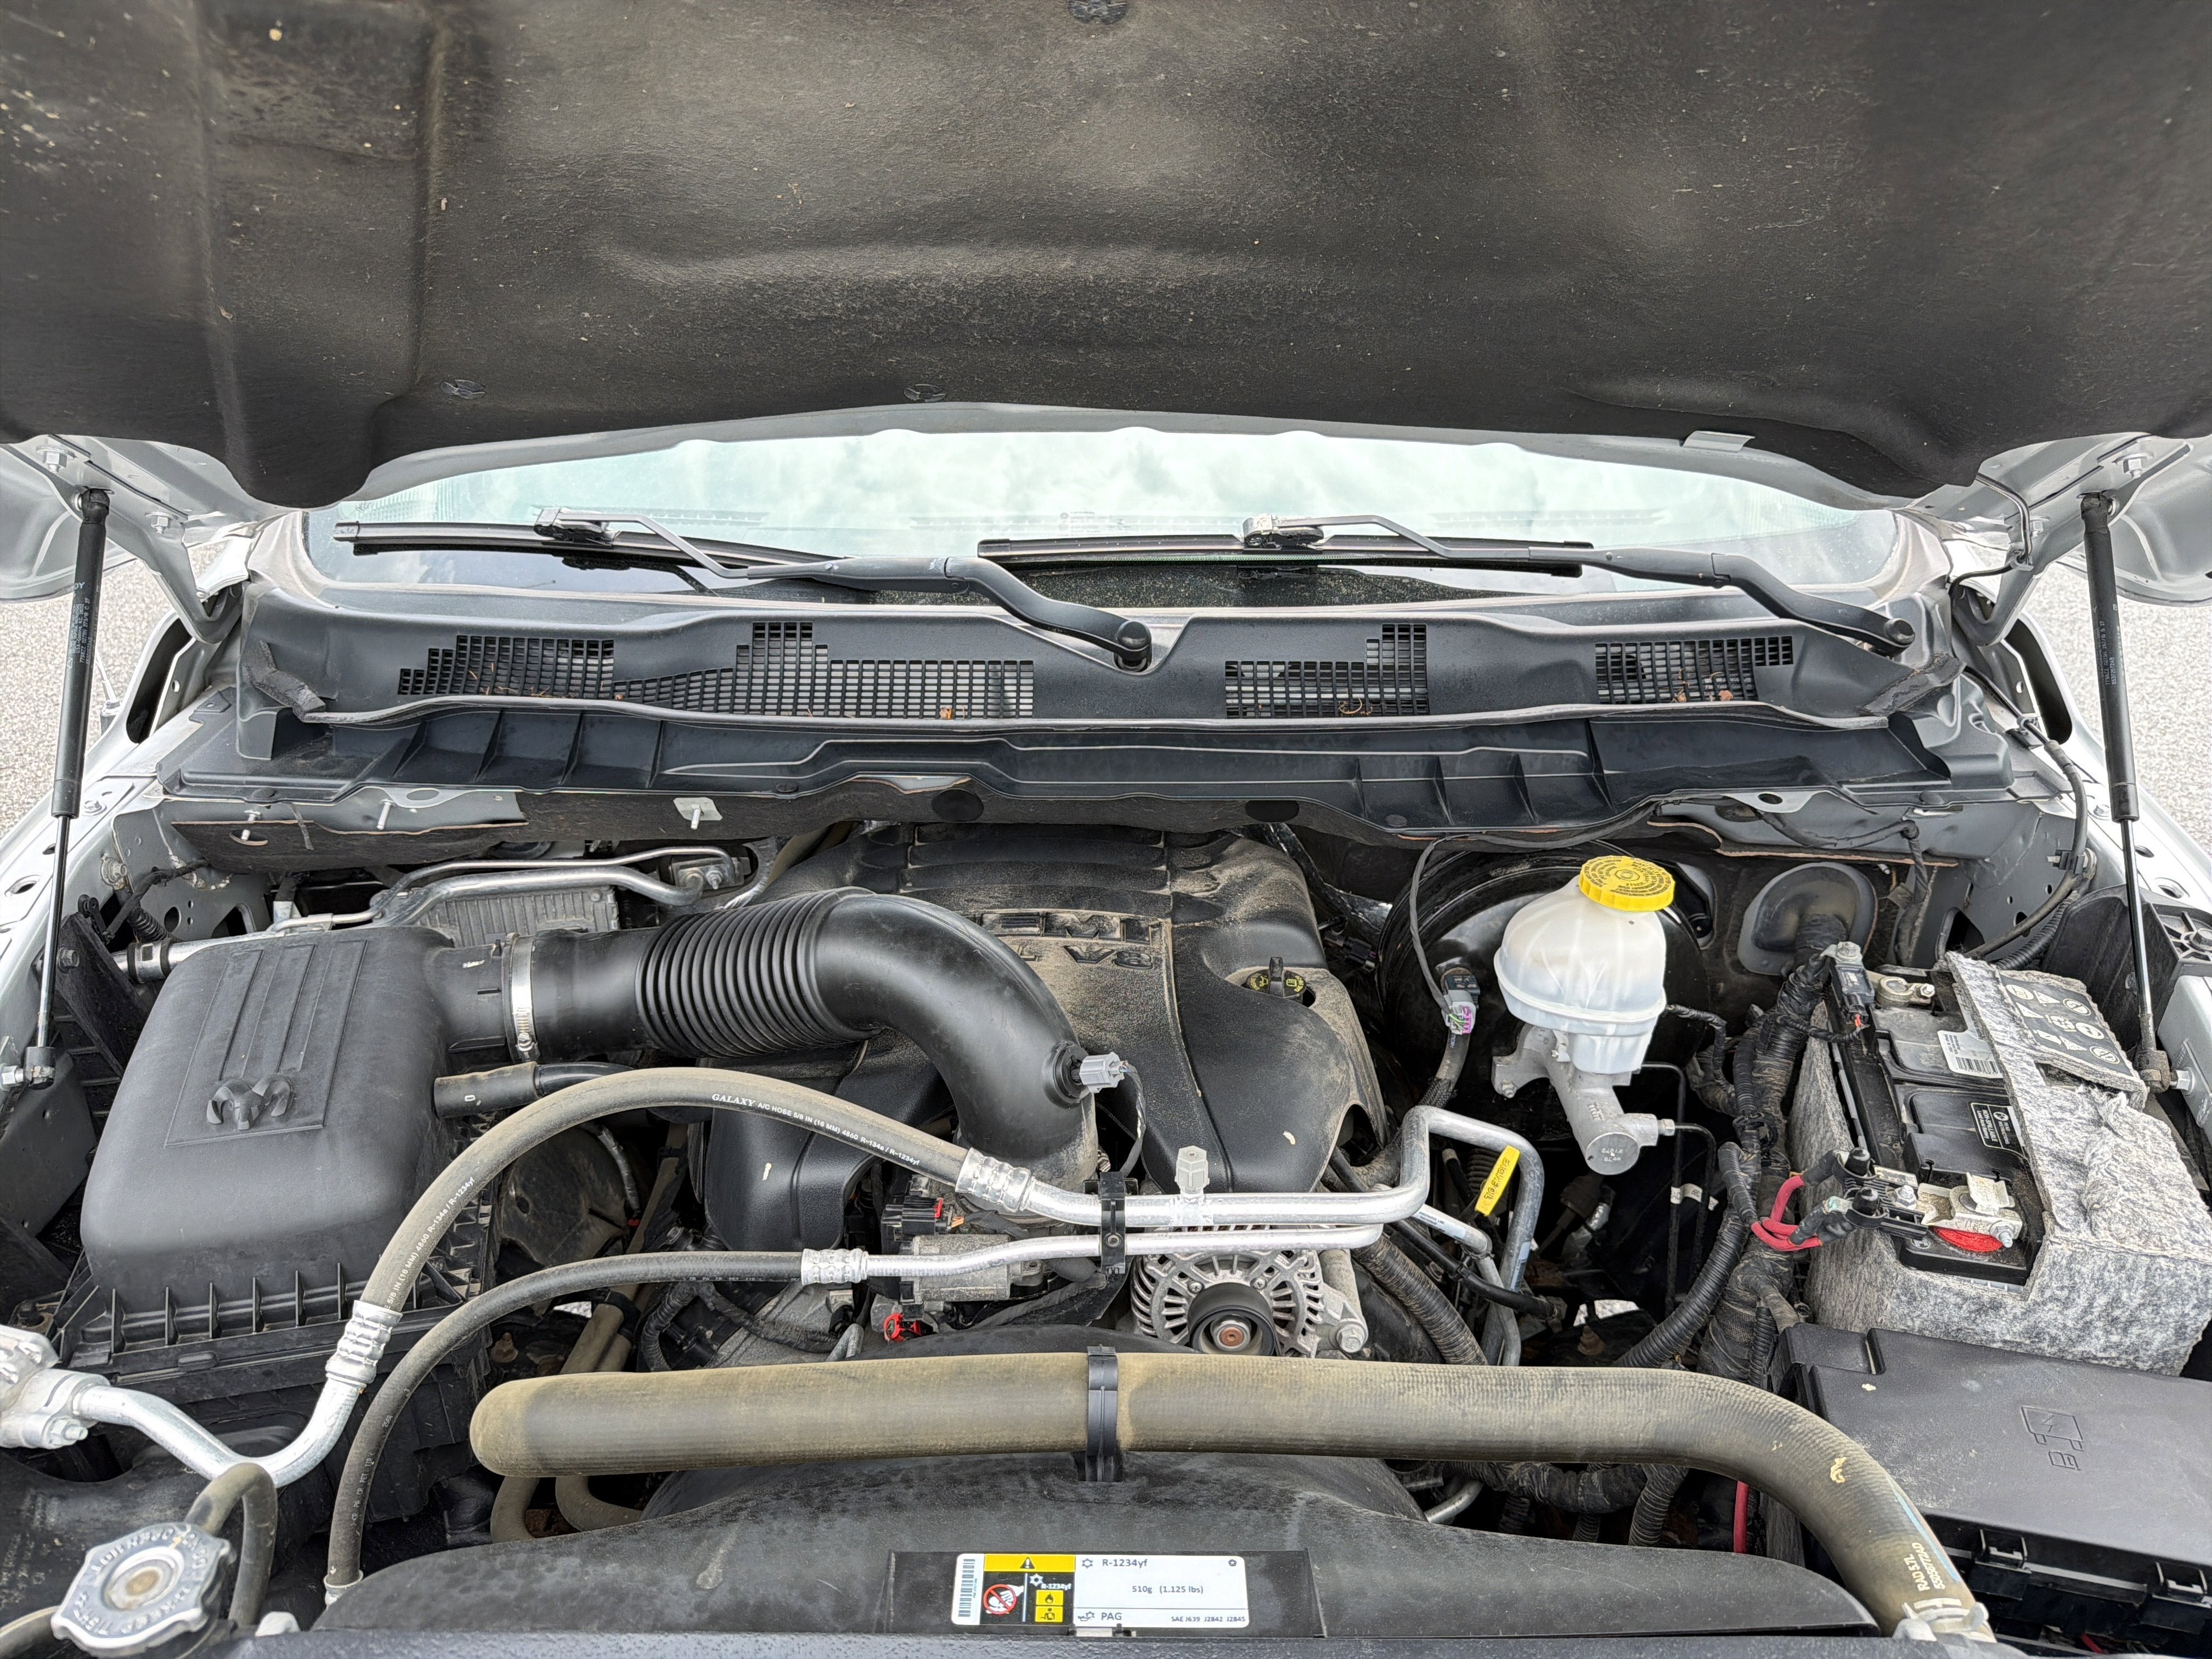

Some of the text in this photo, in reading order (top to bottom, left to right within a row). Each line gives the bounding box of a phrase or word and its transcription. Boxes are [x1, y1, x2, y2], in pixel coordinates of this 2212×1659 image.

[1063, 945, 1154, 970] V8
[712, 1093, 757, 1107] GALAXY
[758, 1102, 770, 1110] A/C
[771, 1105, 792, 1116] HOSE
[793, 1111, 804, 1120] 5/8
[814, 1119, 825, 1127] (16
[826, 1122, 840, 1134] MM)
[842, 1129, 859, 1141] 4860
[860, 1136, 885, 1151] R-134a
[889, 1148, 920, 1166] R-1234yf
[1483, 1187, 1497, 1200] OIL
[387, 1289, 397, 1304] 5/8
[394, 1282, 402, 1290] IN
[399, 1269, 409, 1282] (16
[405, 1251, 419, 1269] MM)
[415, 1233, 430, 1251] 4860
[427, 1208, 449, 1233] R-134a
[448, 1176, 476, 1205] R-1234yf
[359, 1473, 369, 1483] PET
[127, 1528, 174, 1549] OPEN
[1102, 1558, 1148, 1568] R-1234yf
[1911, 1571, 1931, 1591] RAD
[1132, 1585, 1204, 1594] 510g (1.125 lbs)
[1101, 1612, 1122, 1621] PAG
